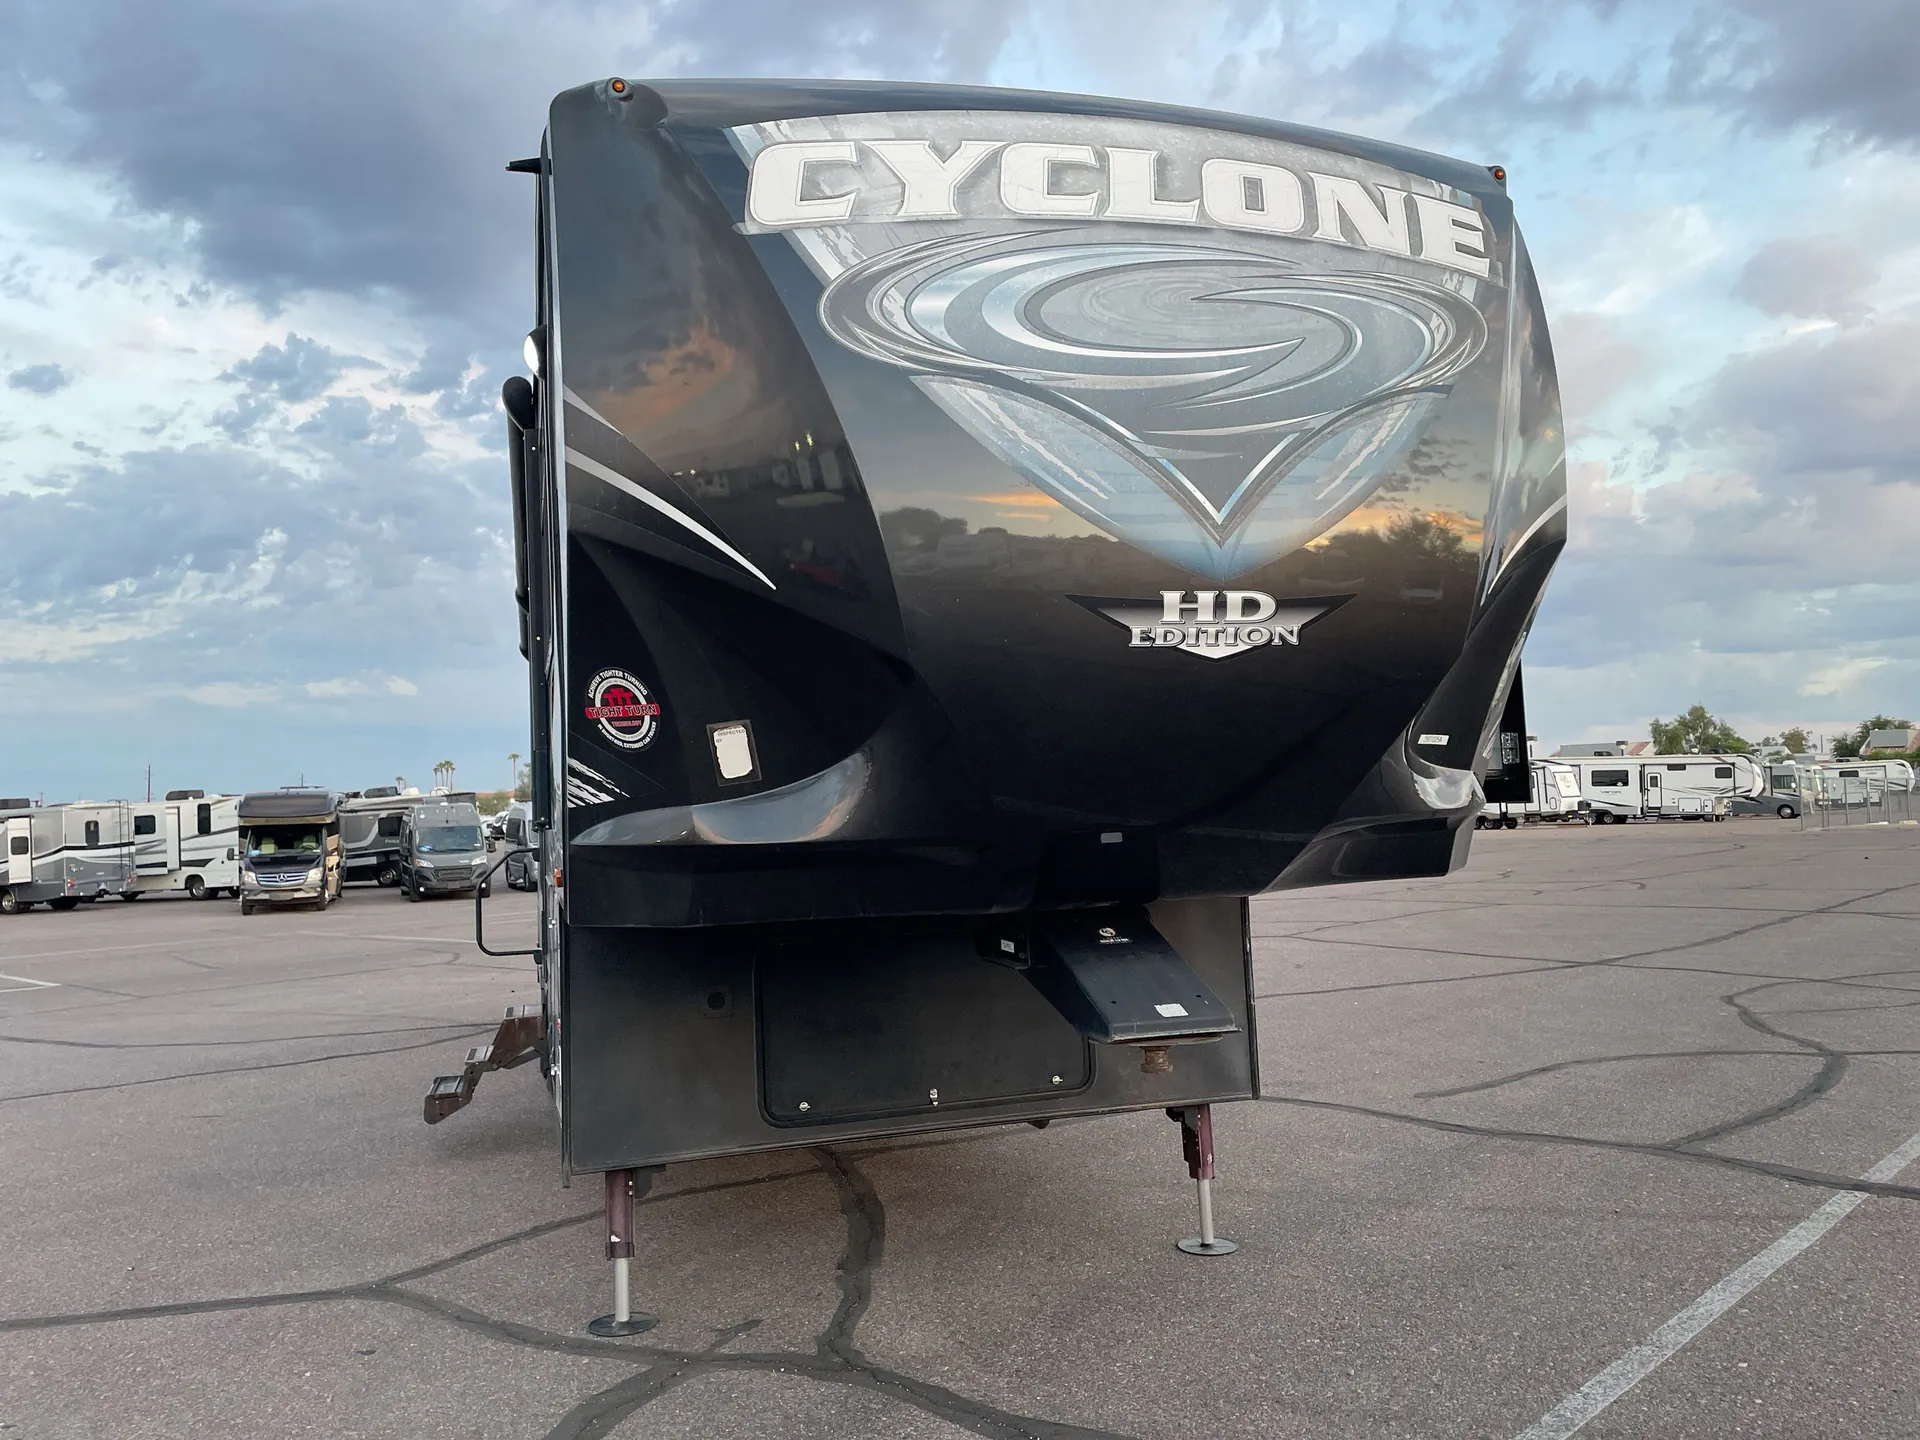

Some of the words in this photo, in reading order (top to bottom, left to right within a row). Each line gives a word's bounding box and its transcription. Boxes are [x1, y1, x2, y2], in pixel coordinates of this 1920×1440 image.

[748, 140, 1490, 278] CYCLONE
[1159, 590, 1278, 624] HD
[1129, 625, 1300, 646] EDITION
[588, 675, 602, 699] ACHIEVE
[600, 670, 623, 679] TIGHTER
[624, 672, 648, 696] TURNING
[590, 706, 623, 717] TIGHT
[626, 705, 657, 716] TURN
